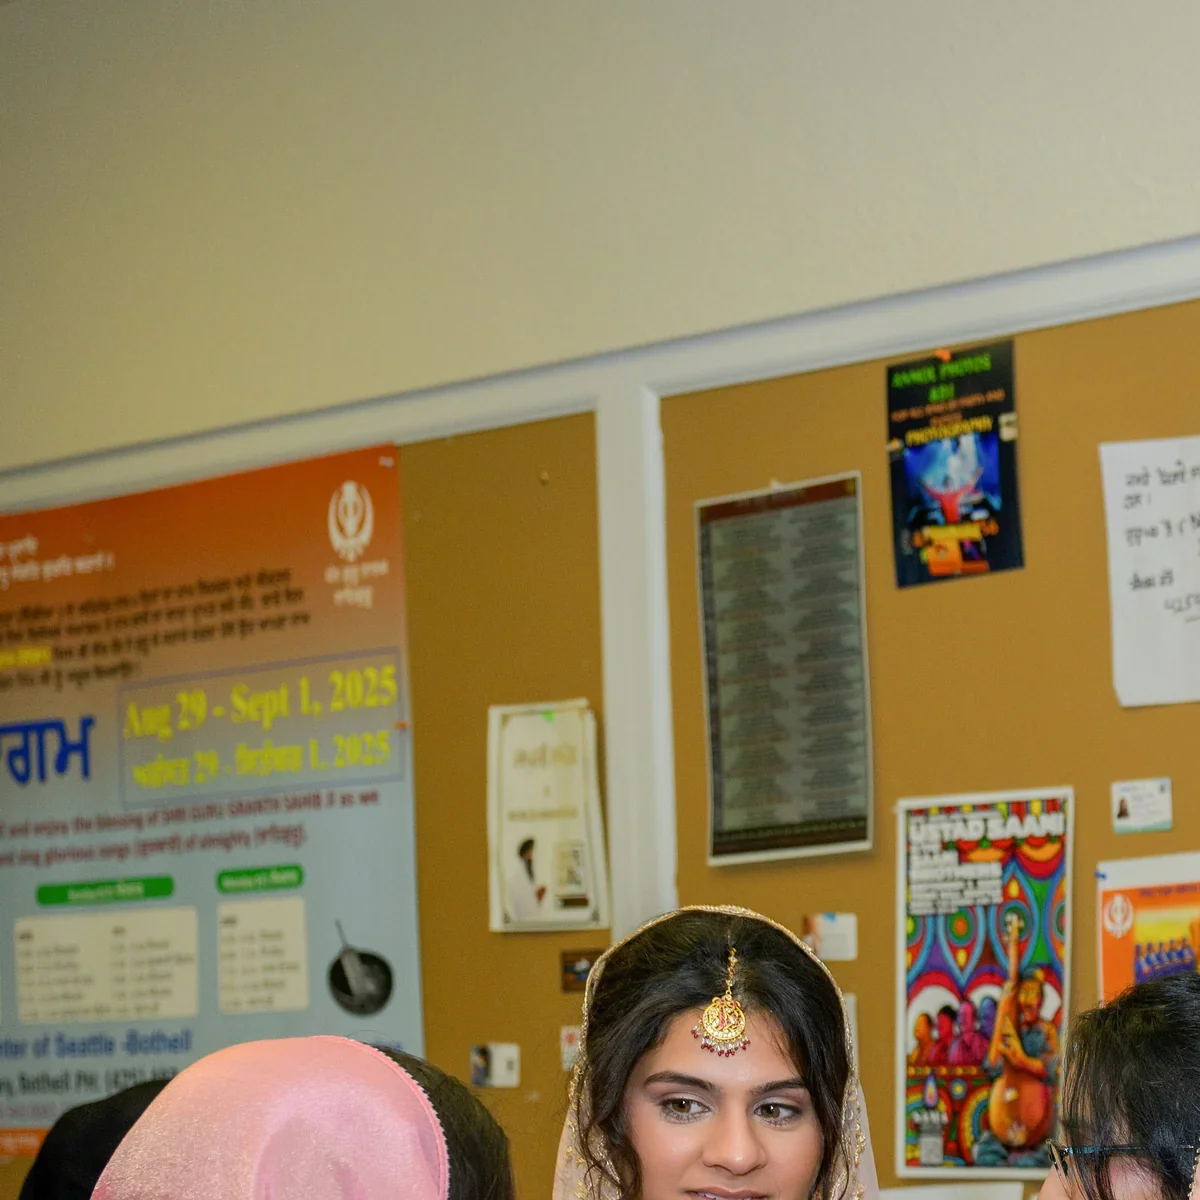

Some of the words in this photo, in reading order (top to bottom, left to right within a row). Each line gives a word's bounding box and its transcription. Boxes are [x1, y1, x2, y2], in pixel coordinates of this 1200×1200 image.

[122, 701, 173, 743] Aug
[176, 688, 207, 731] 29
[230, 682, 290, 731] Sept
[299, 676, 322, 718] 1,
[329, 665, 398, 712] 2025
[0, 714, 95, 785] ਗਮ
[333, 730, 391, 769] 2025
[910, 817, 984, 842] USTAD
[32, 1034, 49, 1059] of
[55, 1031, 116, 1059] Seattle
[18, 1069, 69, 1094] Bothell
